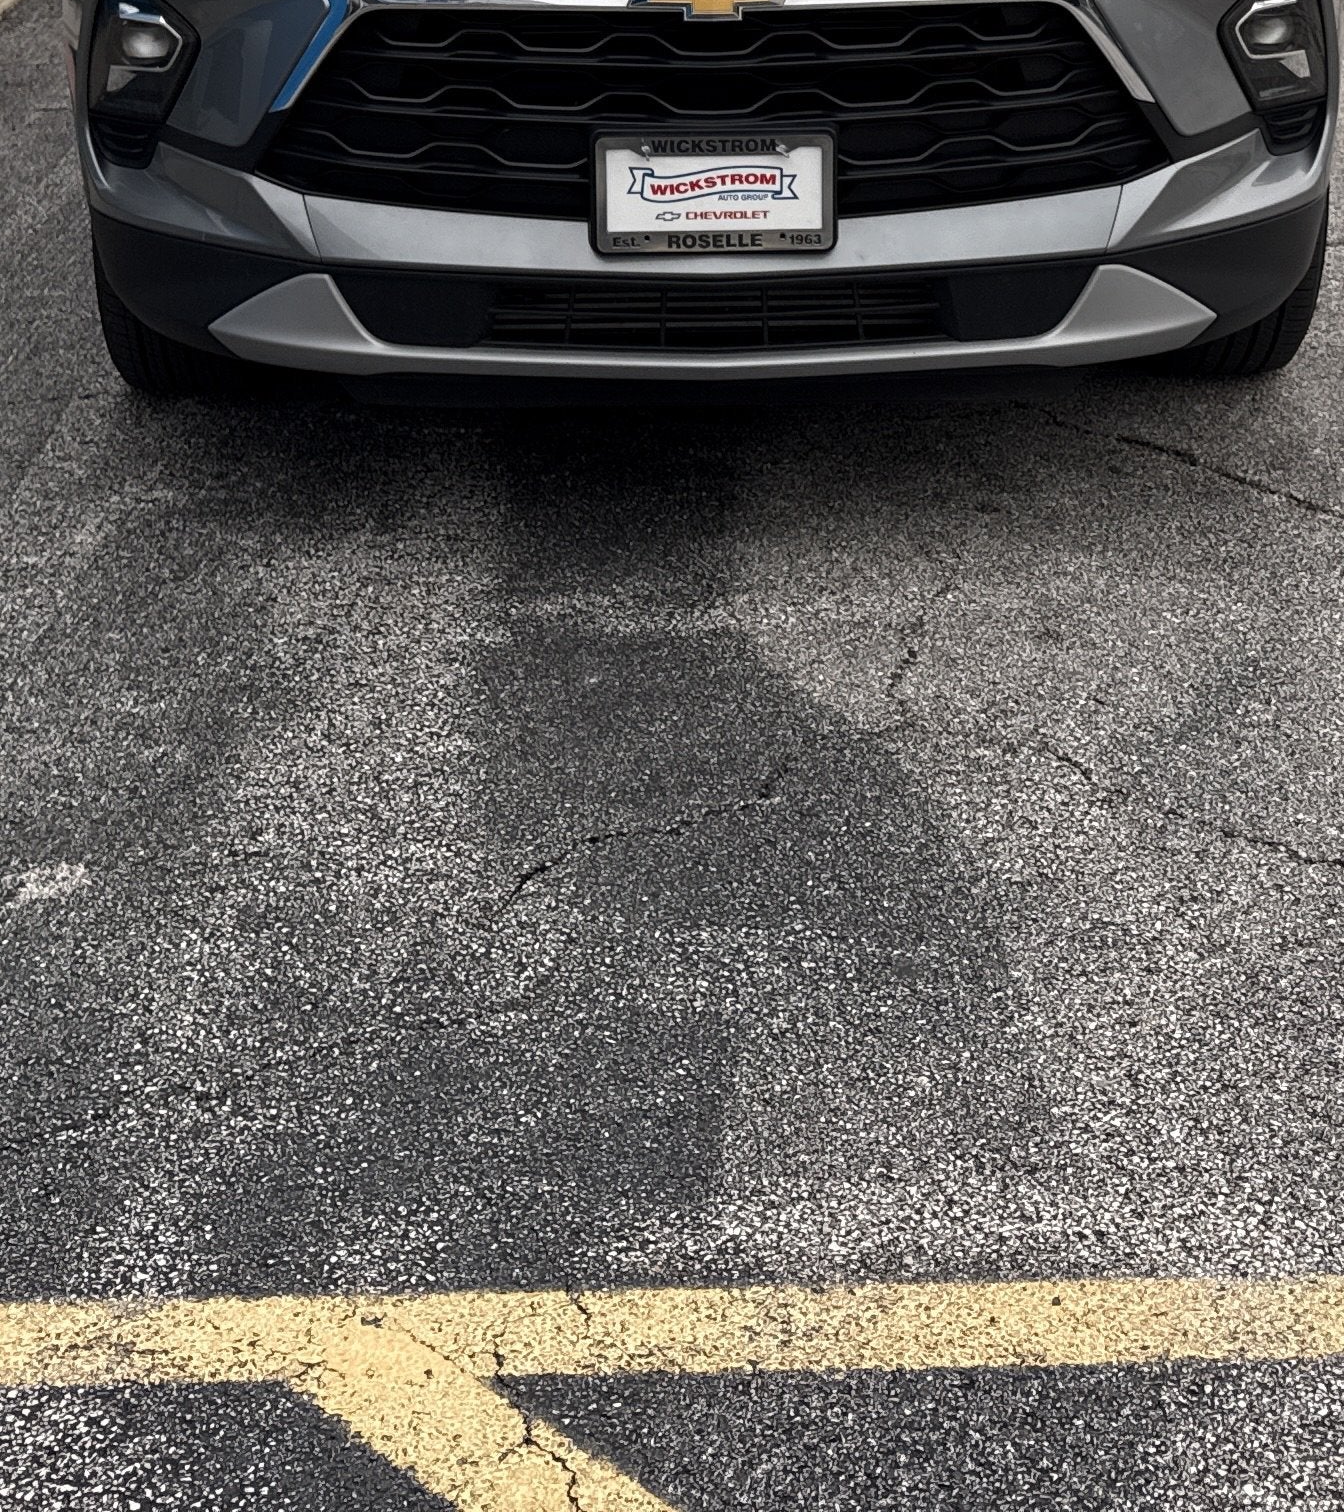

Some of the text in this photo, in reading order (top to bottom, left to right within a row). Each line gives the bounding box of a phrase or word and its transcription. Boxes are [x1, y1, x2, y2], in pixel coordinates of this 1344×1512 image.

[651, 138, 777, 154] WICKSTROM
[650, 173, 777, 196] WICKSTROM
[741, 193, 769, 201] GROUP
[685, 210, 770, 220] CHEVROLET
[612, 233, 822, 249] Est. ROSELLE 1963
